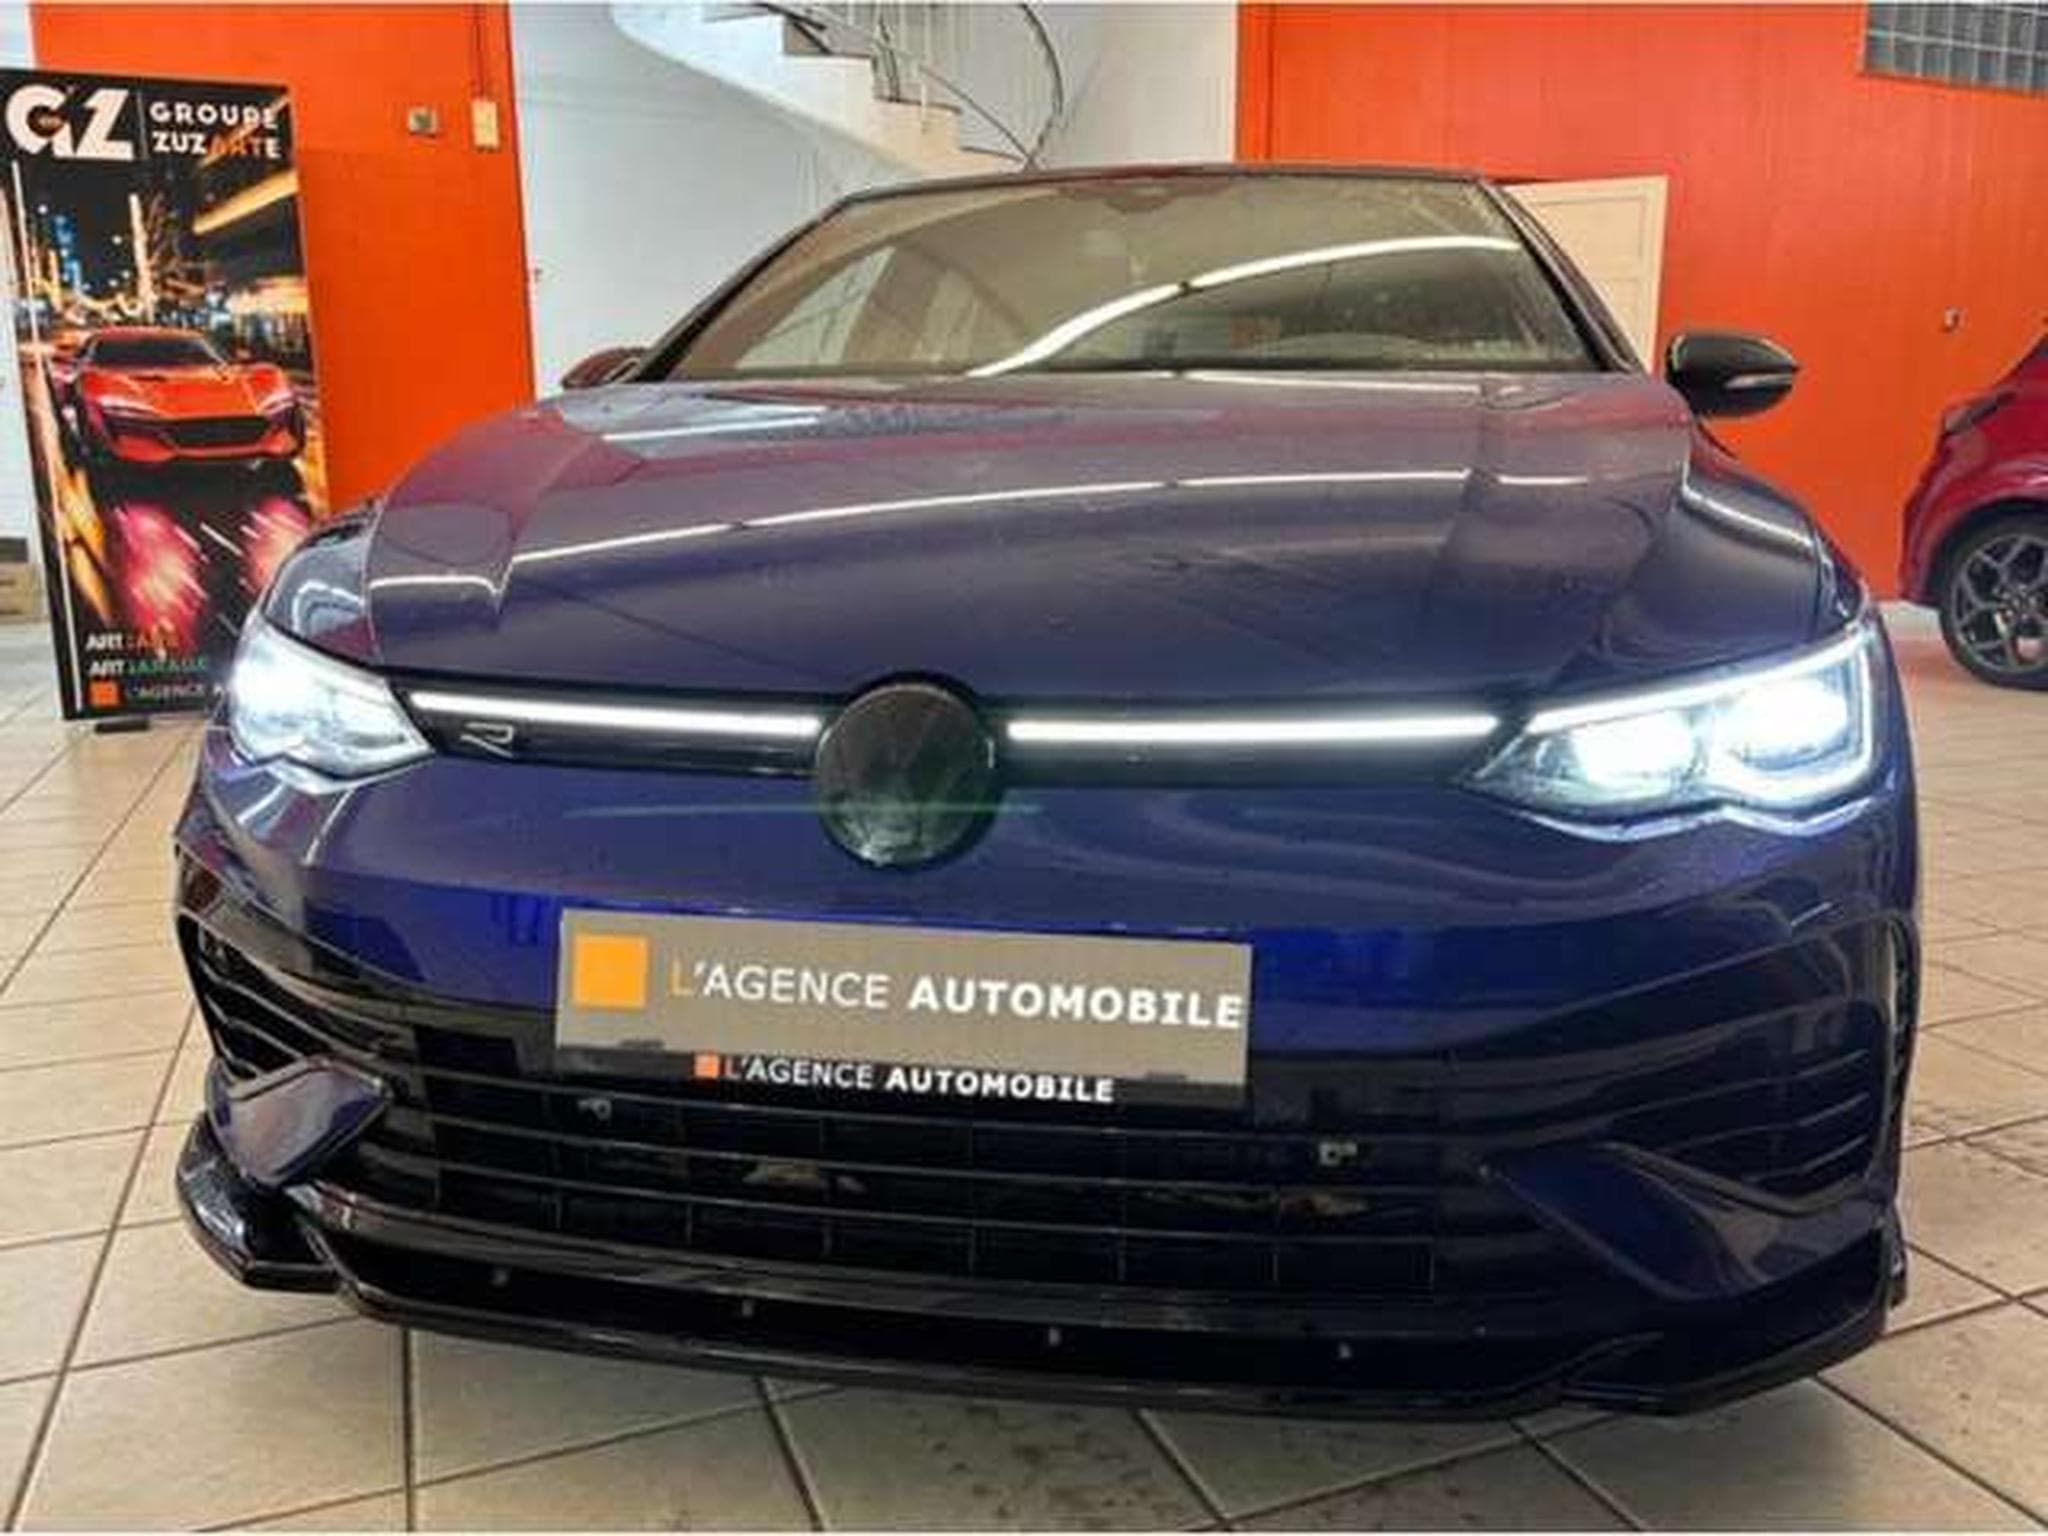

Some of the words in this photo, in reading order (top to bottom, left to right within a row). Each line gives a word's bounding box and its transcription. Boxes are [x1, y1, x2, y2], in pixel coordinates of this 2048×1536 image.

[149, 101, 280, 129] GROUPE
[670, 957, 892, 1010] L'AGENCE
[906, 974, 1243, 1029] AUTOMOBILE
[724, 1054, 875, 1090] L'AGENCE
[885, 1065, 1115, 1103] AUTOMOBILE
